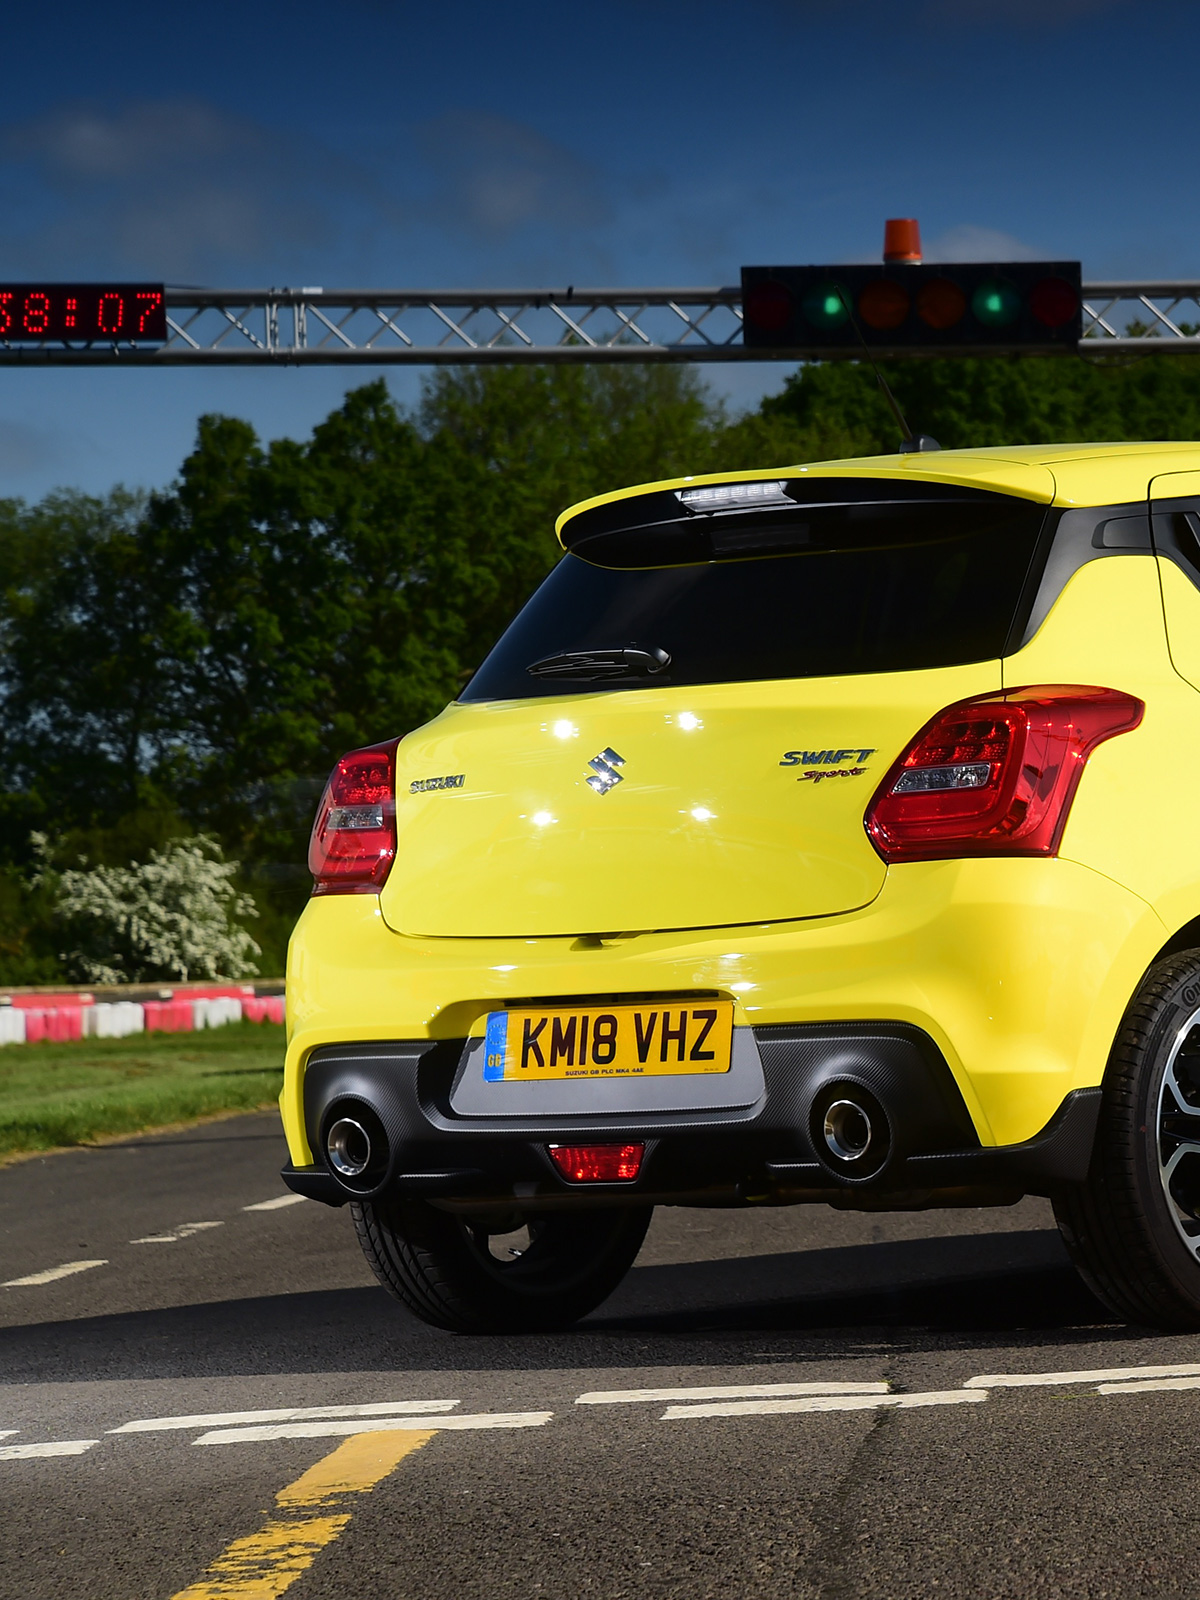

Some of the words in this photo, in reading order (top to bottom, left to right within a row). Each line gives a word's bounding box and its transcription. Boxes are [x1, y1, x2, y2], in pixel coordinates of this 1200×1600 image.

[779, 749, 878, 767] SWIFT
[409, 774, 466, 794] SUZUKI
[796, 767, 868, 784] Sport
[520, 1014, 618, 1069] KM18
[633, 1009, 718, 1064] VHZ
[488, 1053, 501, 1067] GB
